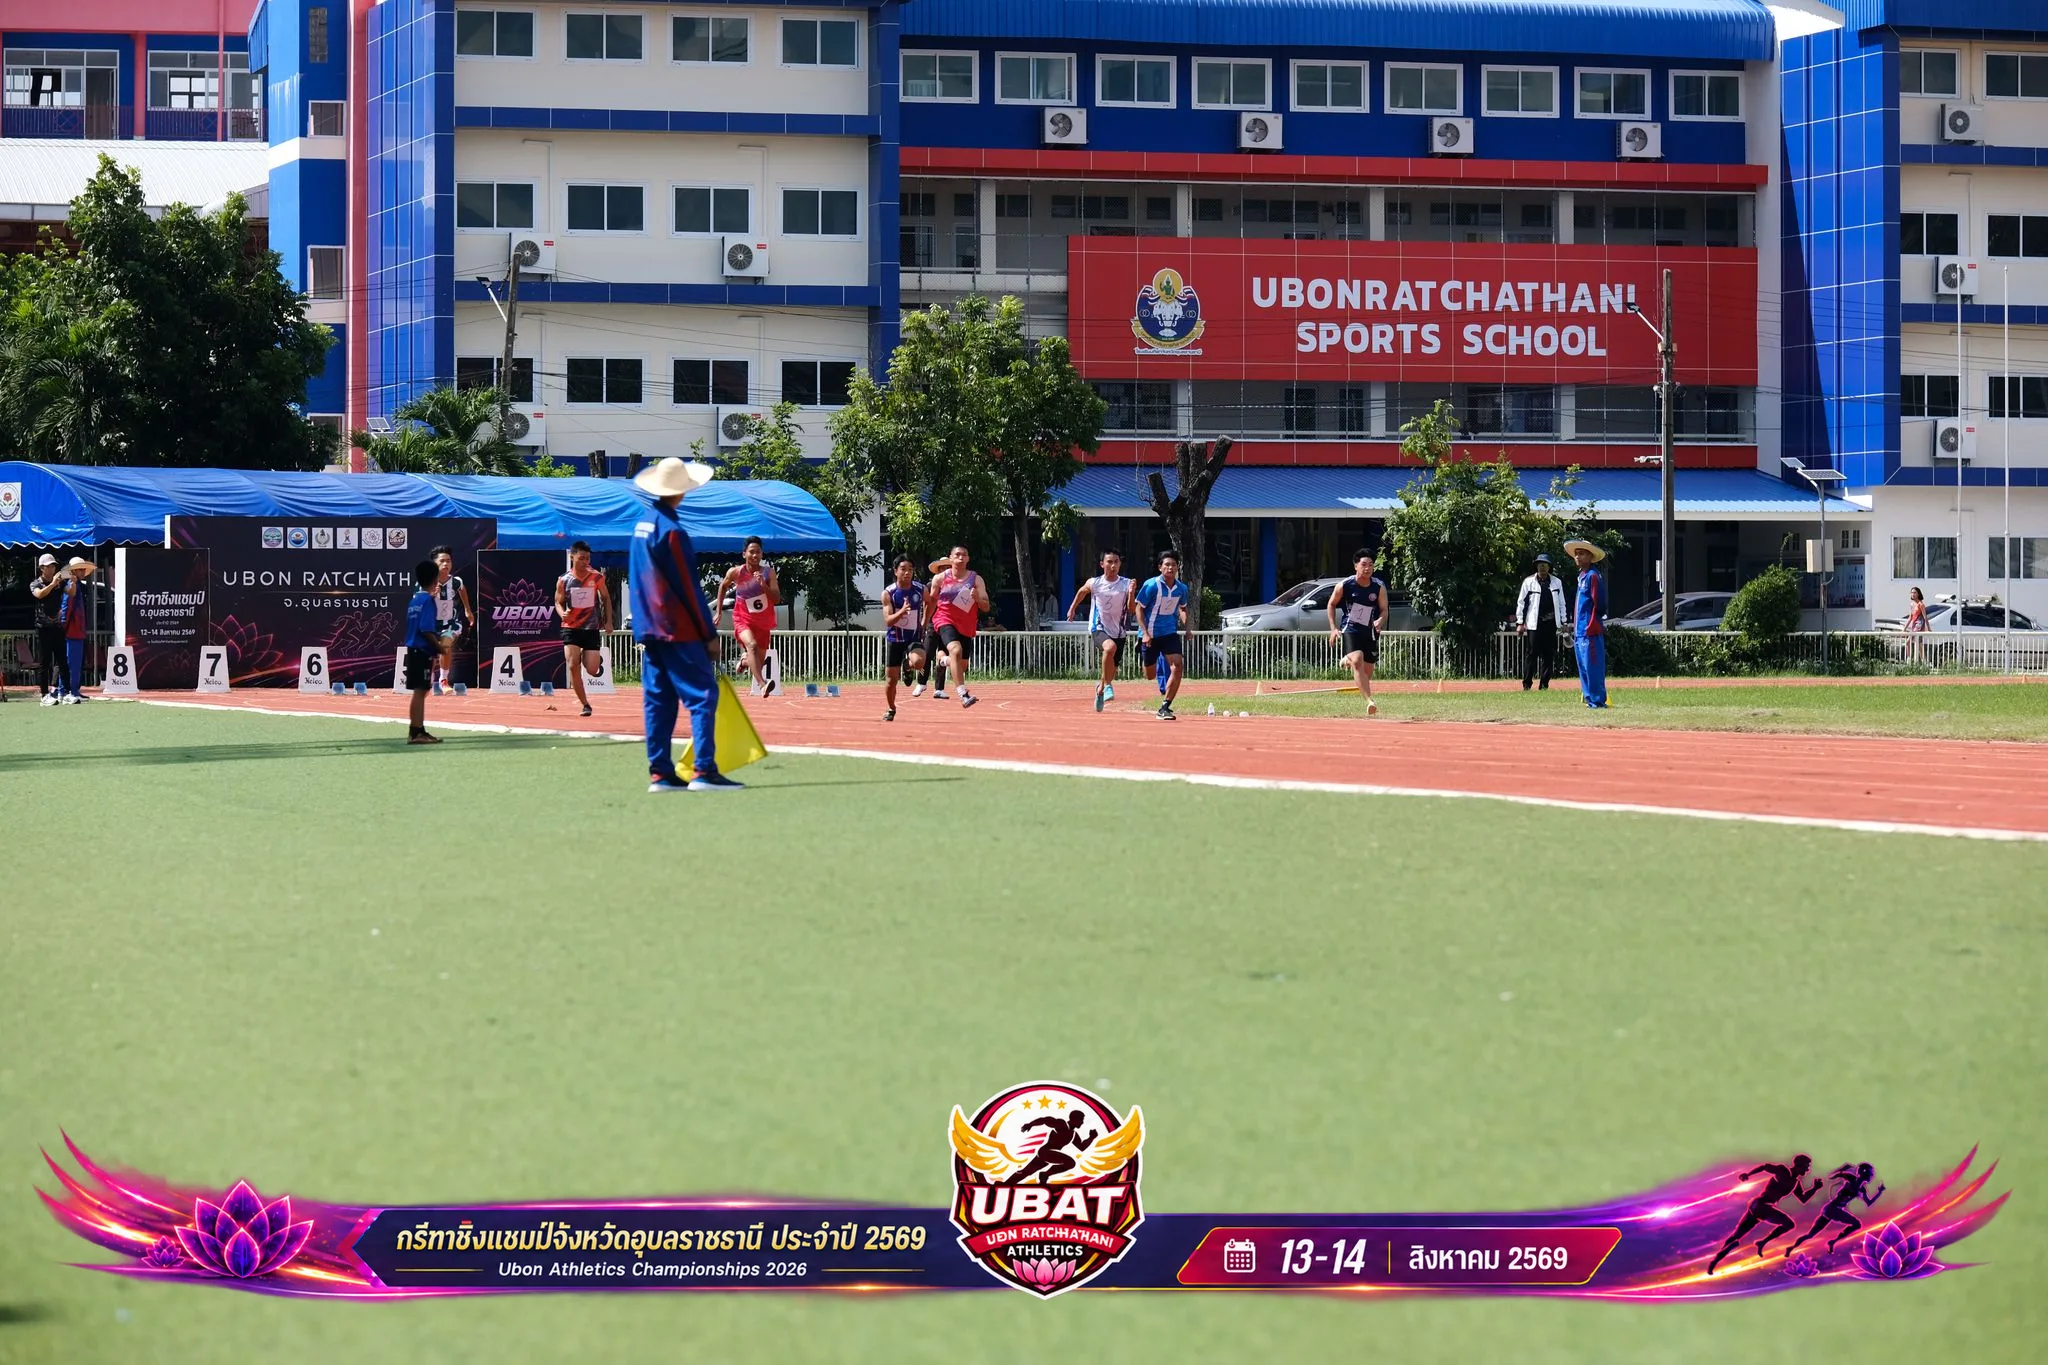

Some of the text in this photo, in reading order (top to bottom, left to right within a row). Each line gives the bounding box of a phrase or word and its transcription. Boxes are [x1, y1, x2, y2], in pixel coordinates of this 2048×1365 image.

[1252, 276, 1636, 314] UBONRATCHATHANI
[1297, 321, 1606, 356] SPORTS SCHOOL
[223, 571, 410, 587] UBON RATCHATH
[491, 605, 555, 620] UBON
[753, 599, 763, 610] 6
[494, 620, 552, 629] ATHLETICS
[113, 653, 128, 677] 8
[206, 653, 221, 677] 7
[307, 653, 322, 676] 6
[500, 654, 515, 678] 4
